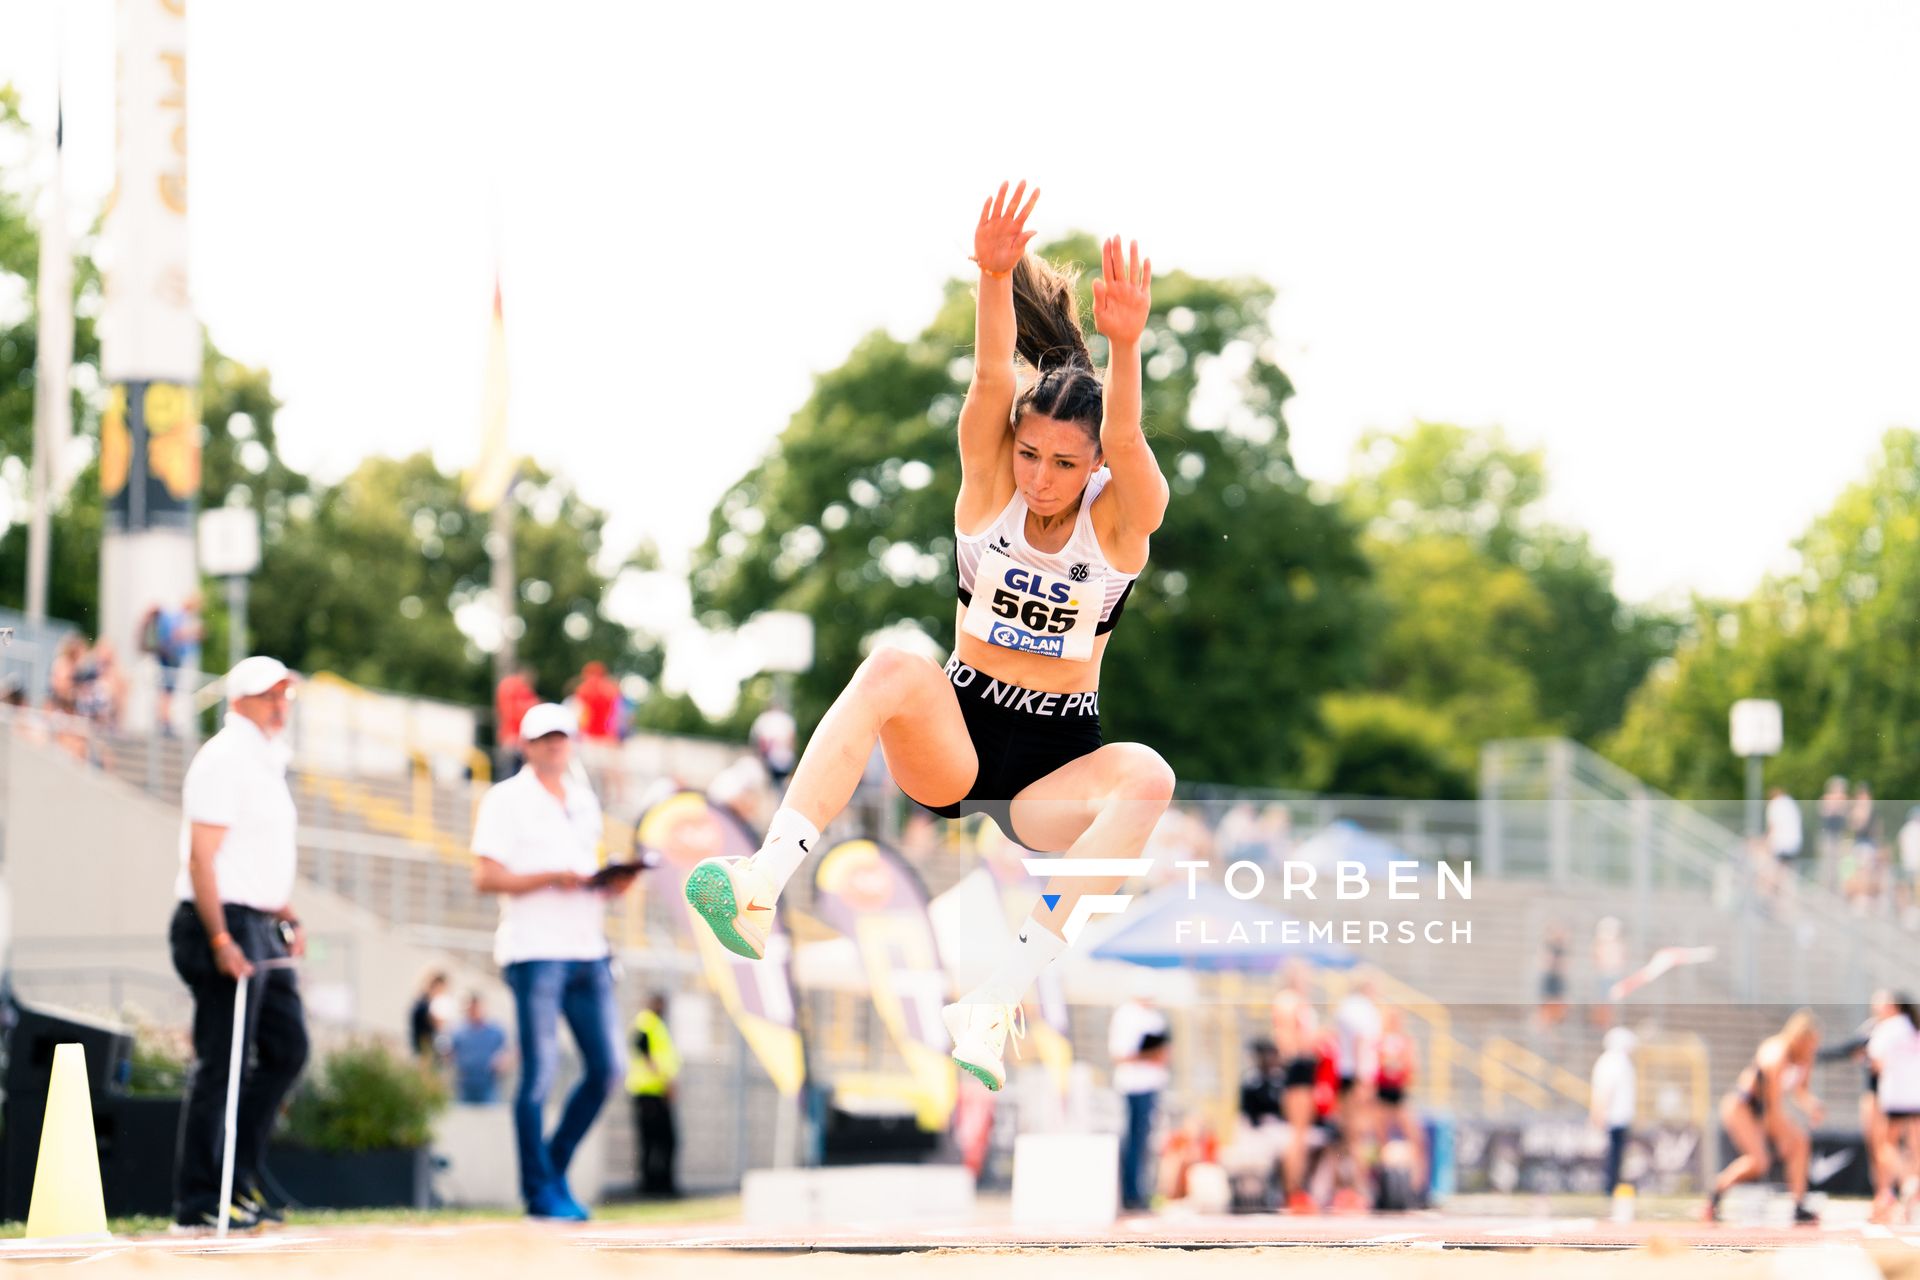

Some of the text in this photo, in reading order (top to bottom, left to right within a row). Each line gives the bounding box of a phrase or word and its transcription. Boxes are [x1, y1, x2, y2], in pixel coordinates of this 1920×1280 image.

[1070, 564, 1088, 580] 96
[991, 588, 1079, 634] 565
[1020, 635, 1061, 652] PLAN
[943, 652, 977, 688] RO
[981, 678, 1062, 716] NIKE
